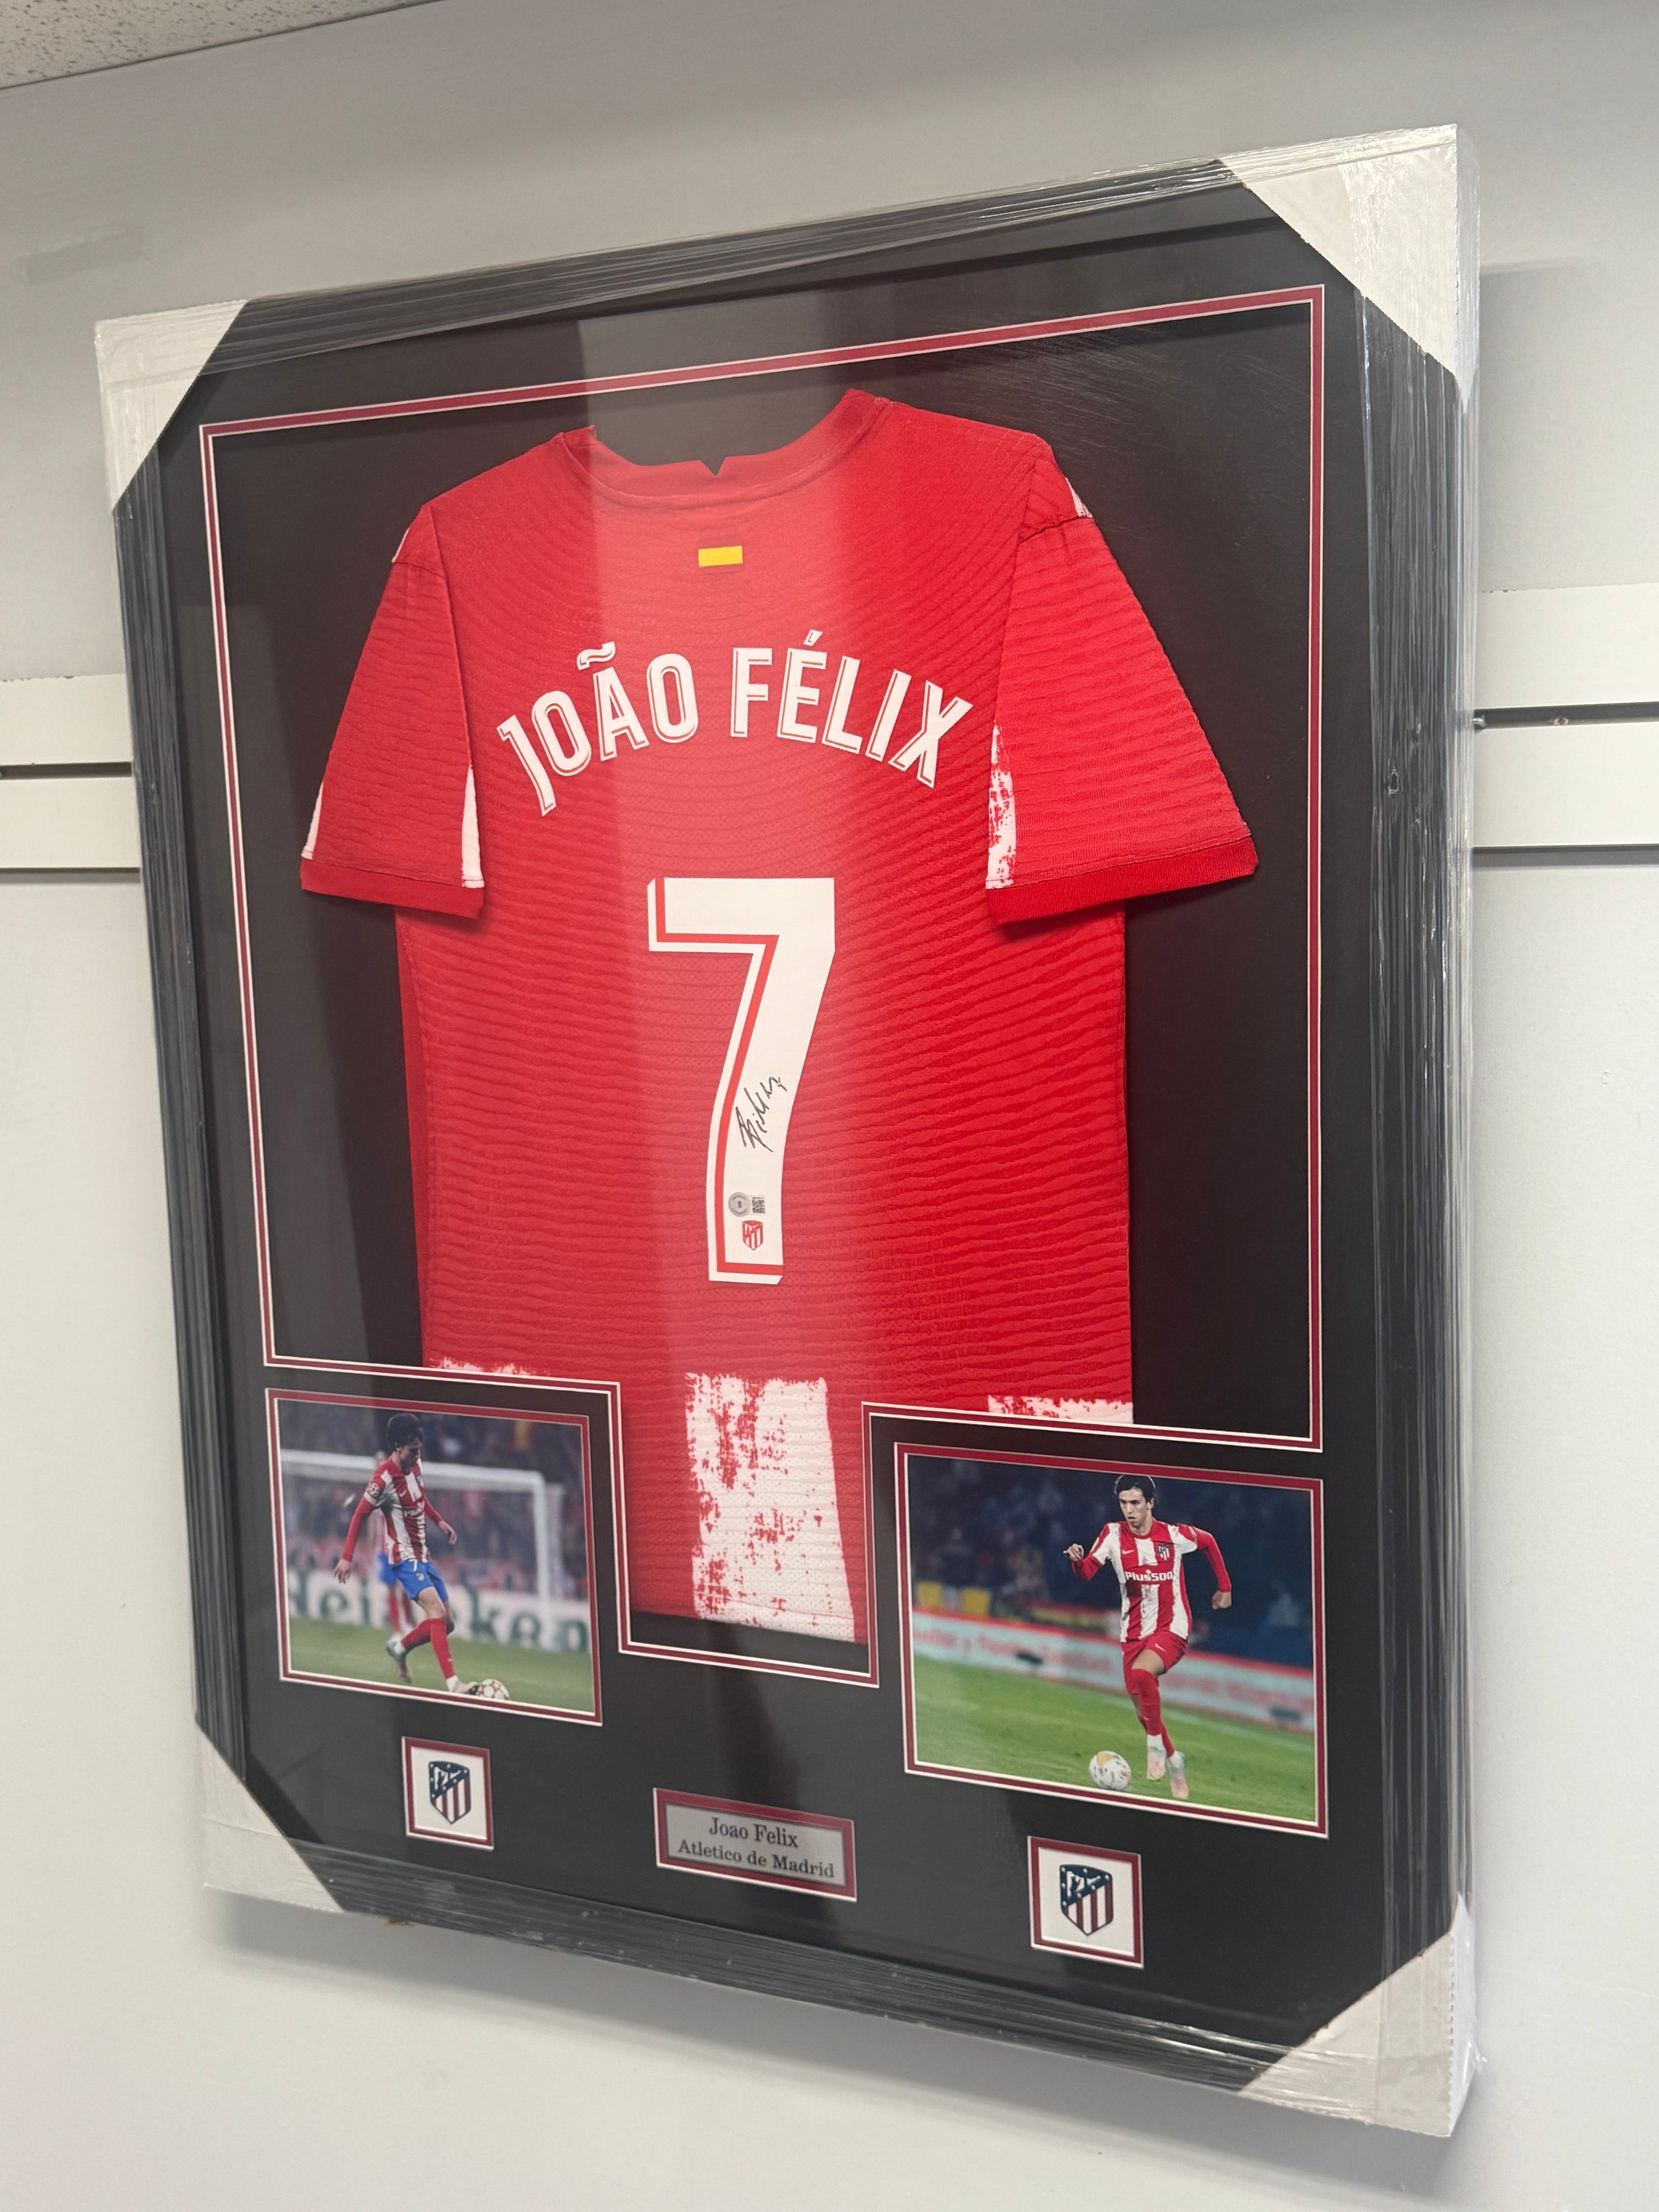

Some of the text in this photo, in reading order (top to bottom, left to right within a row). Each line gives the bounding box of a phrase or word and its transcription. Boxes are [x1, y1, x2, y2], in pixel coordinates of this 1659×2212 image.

[496, 629, 973, 816] JOÃO FÉLIX
[647, 877, 835, 1284] 7
[409, 1559, 418, 1571] 7
[1125, 1570, 1173, 1581] Plus500
[709, 1817, 799, 1848] Joao Felix
[678, 1839, 834, 1878] Atletico de Madrid
